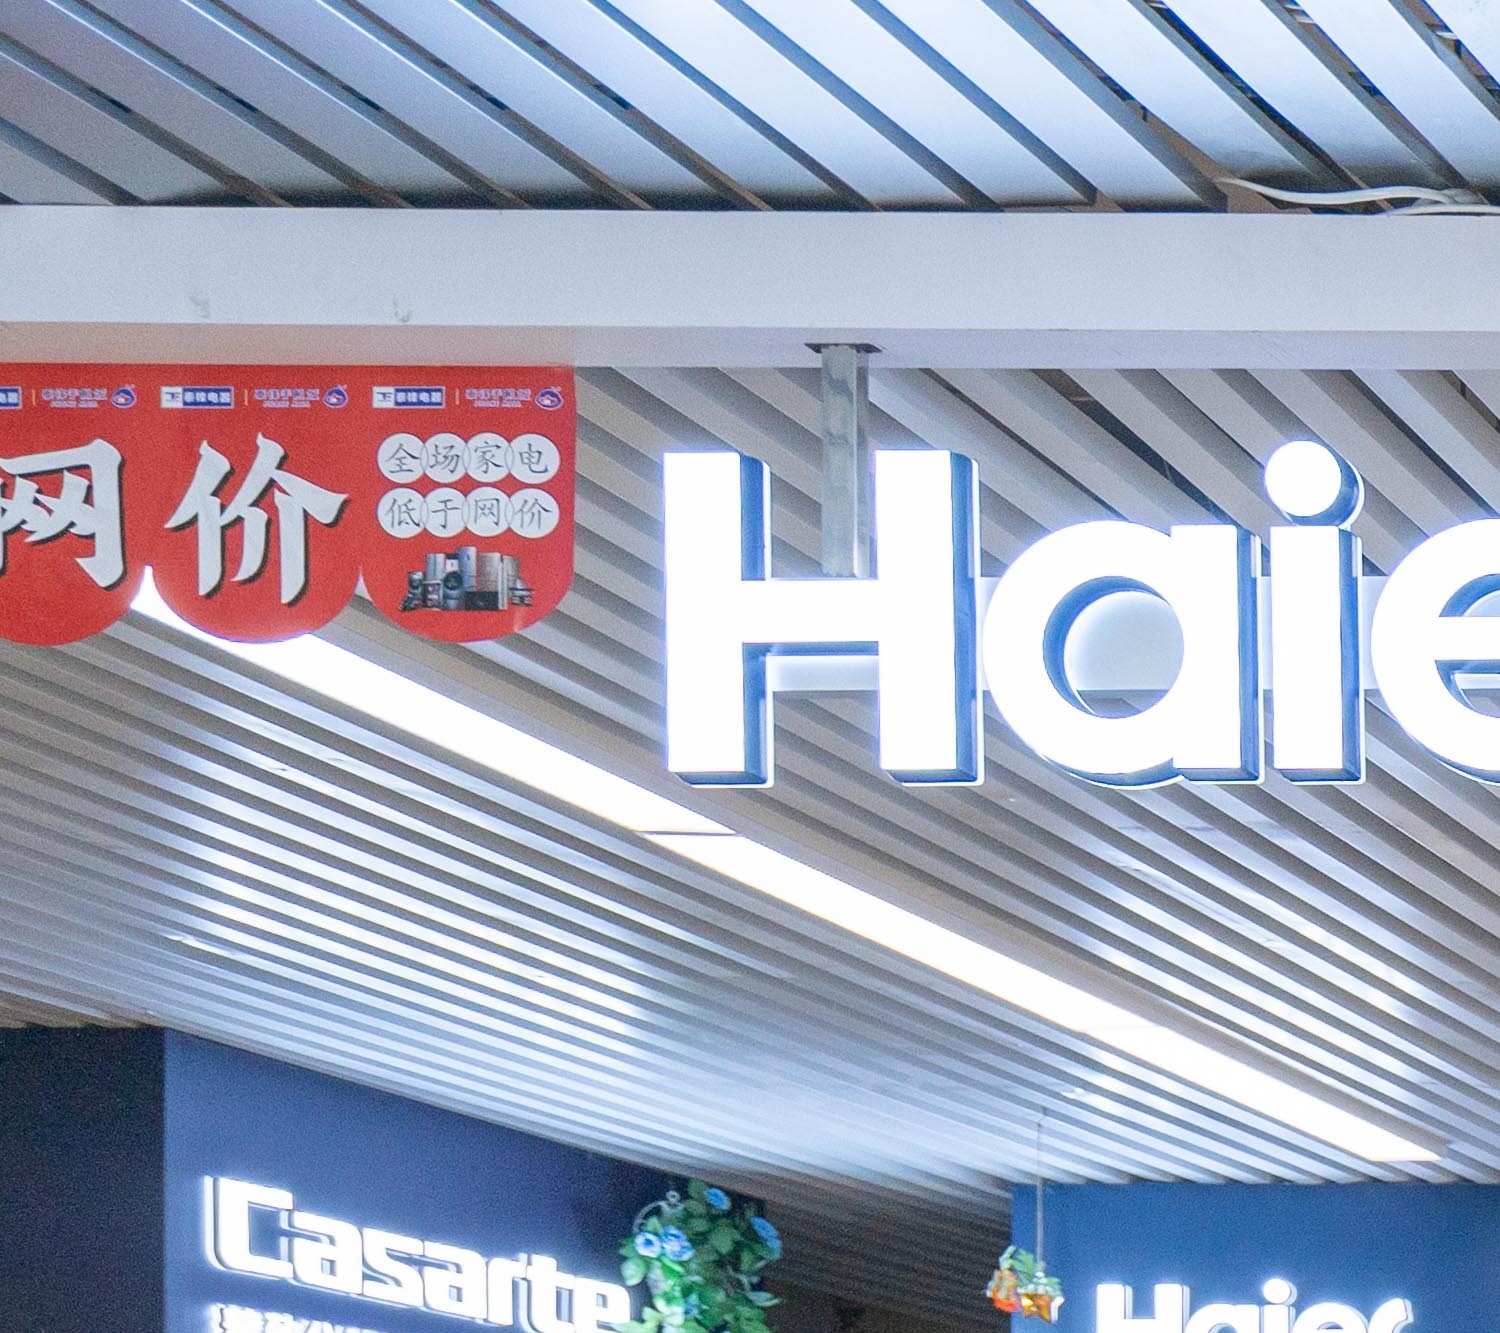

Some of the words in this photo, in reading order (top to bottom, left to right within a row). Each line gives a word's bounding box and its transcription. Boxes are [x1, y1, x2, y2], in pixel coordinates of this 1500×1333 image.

[384, 442, 550, 475] 全场家电
[384, 498, 551, 531] 低于网价
